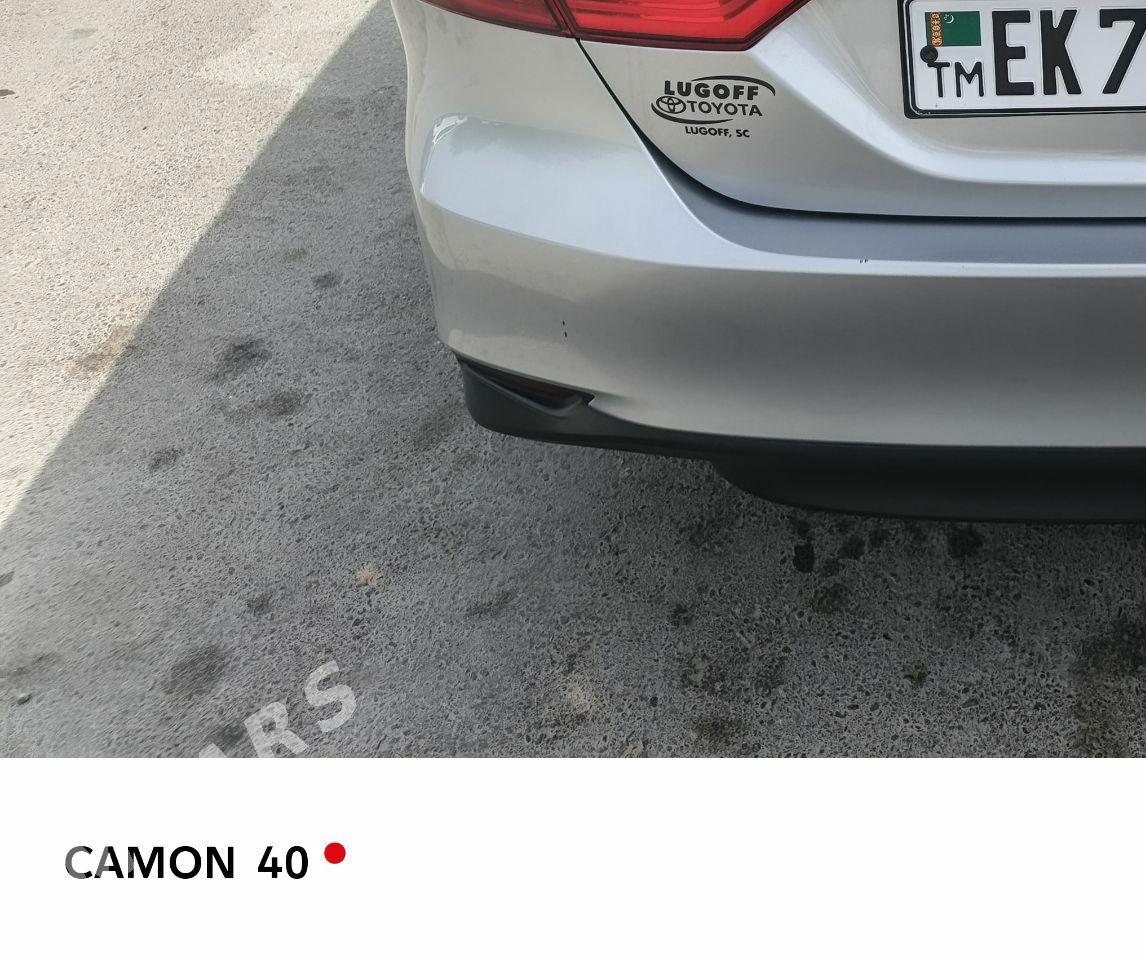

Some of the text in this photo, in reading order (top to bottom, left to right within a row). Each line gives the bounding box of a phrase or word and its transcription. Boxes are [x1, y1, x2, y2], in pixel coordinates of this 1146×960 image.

[927, 62, 985, 98] TM
[664, 80, 759, 101] LUGOFF
[687, 100, 763, 116] TOYOTA
[685, 126, 750, 138] LUGOFF, SC
